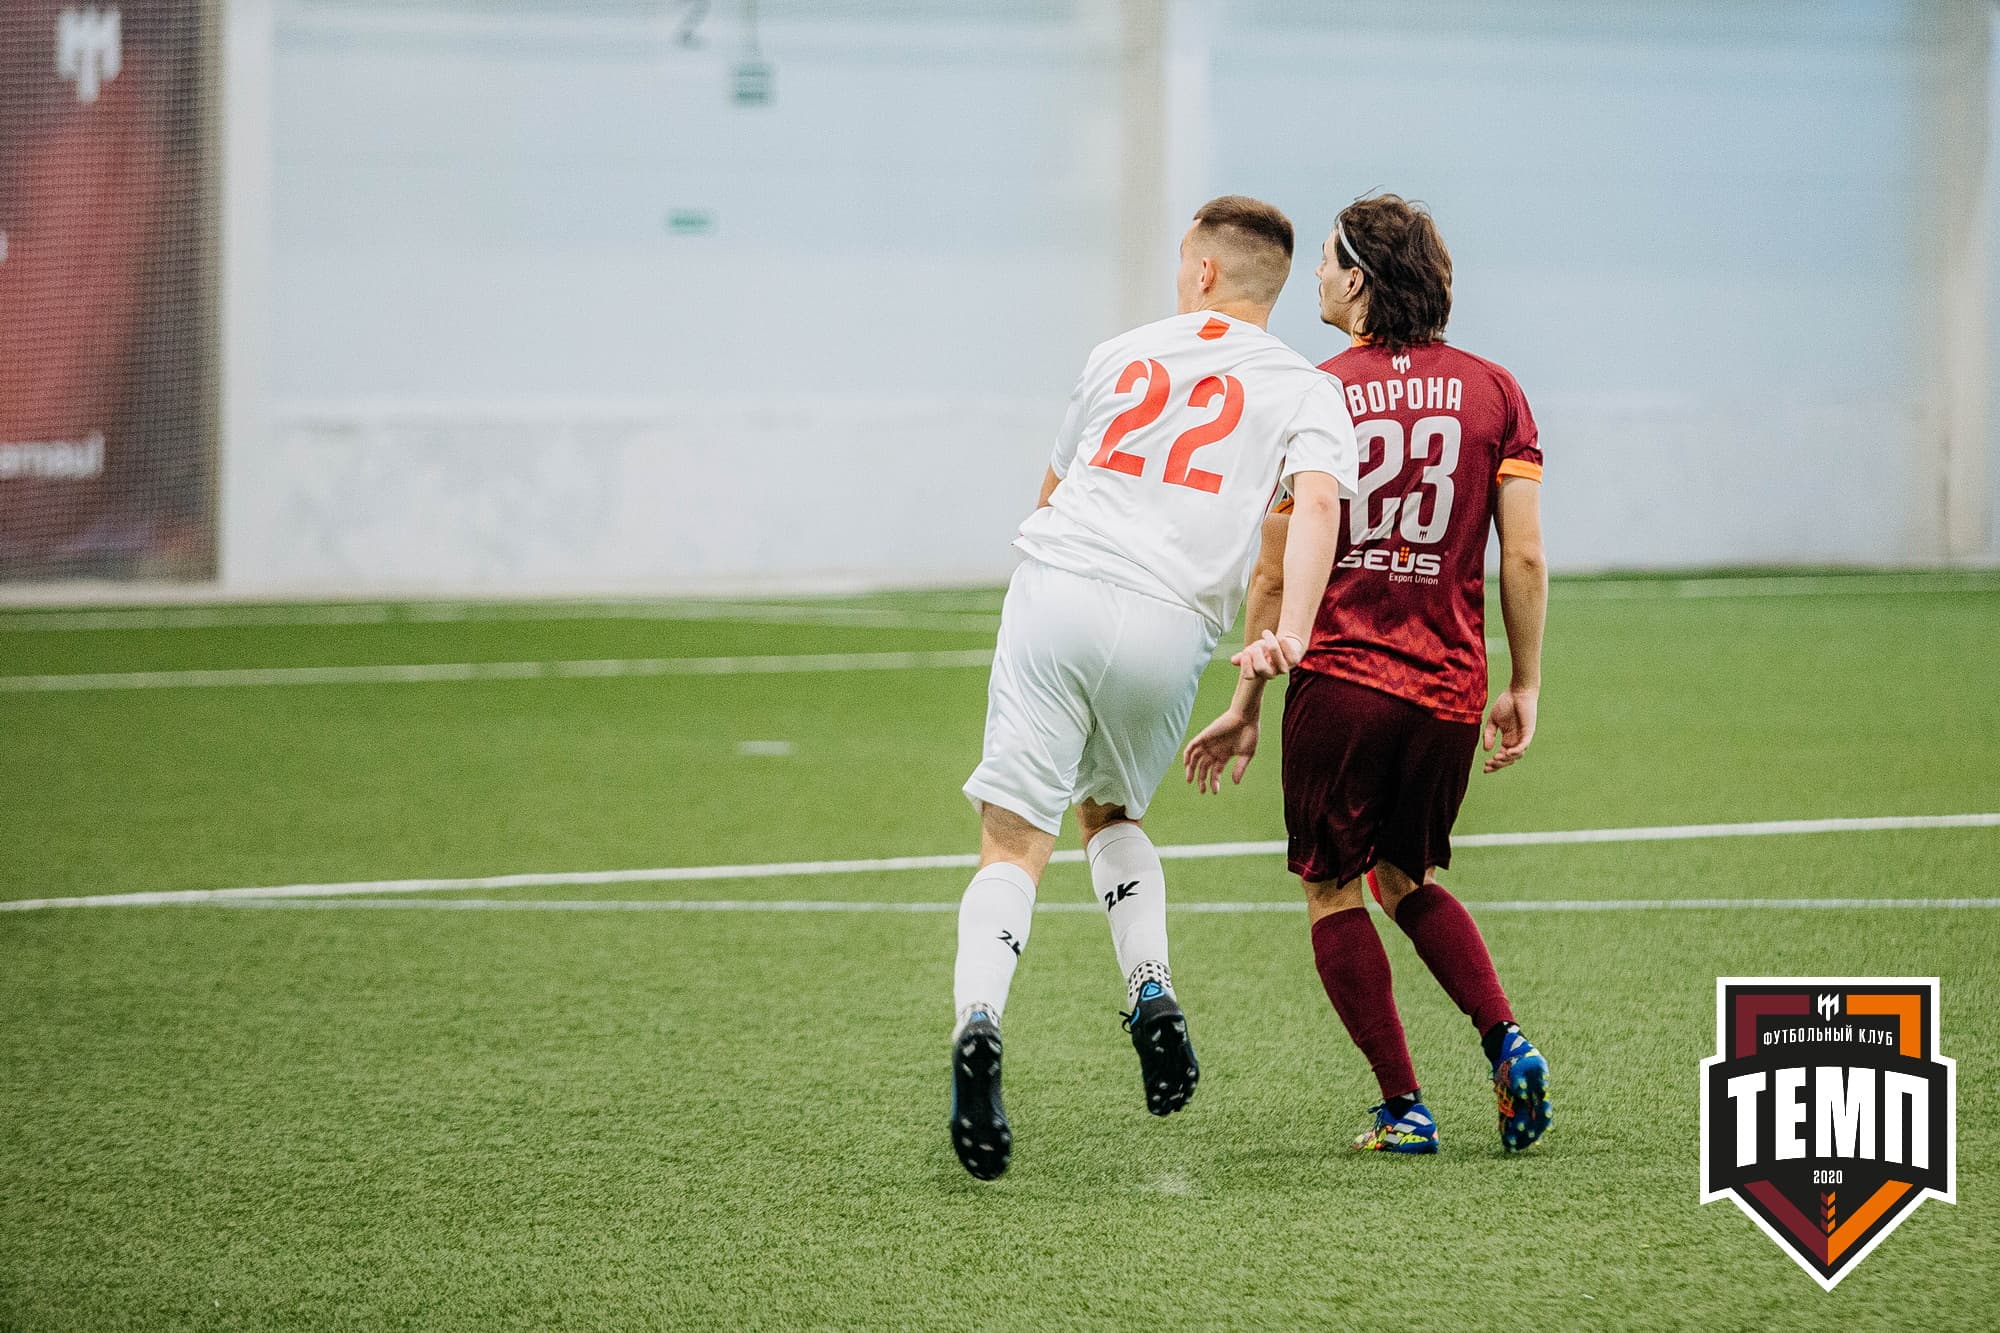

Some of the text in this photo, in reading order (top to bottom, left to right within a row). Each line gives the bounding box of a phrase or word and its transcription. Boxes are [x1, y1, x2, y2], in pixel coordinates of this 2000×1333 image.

[1346, 377, 1463, 417] ВОРОНА
[1088, 358, 1245, 495] 22
[1350, 416, 1462, 545] 23
[1337, 547, 1441, 575] SEUS
[1388, 572, 1439, 585] Export Union
[1104, 880, 1141, 913] 2K
